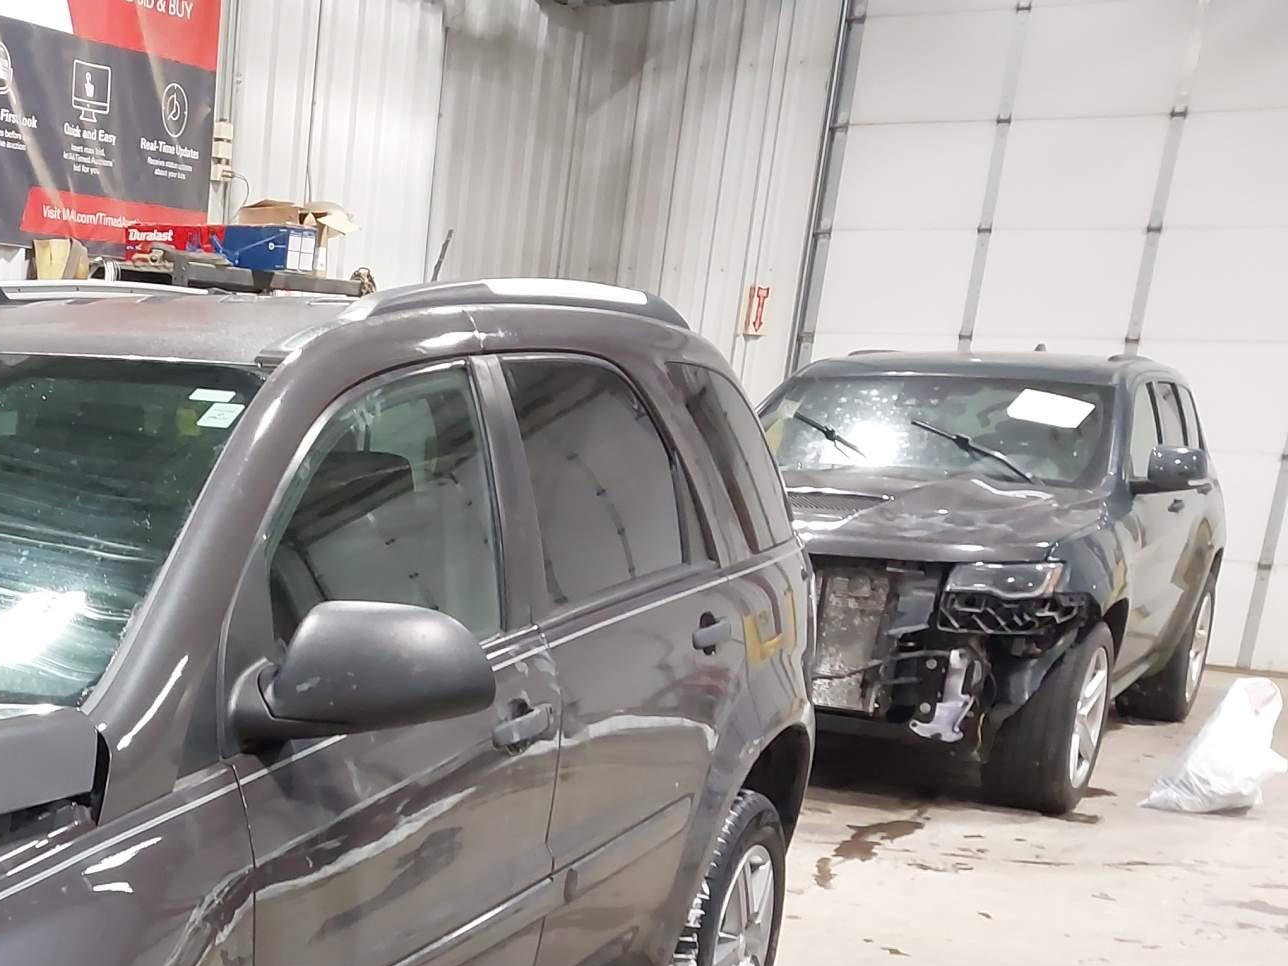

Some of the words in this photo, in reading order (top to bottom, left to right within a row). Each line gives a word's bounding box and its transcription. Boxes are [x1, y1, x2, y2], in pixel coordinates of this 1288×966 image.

[168, 0, 193, 20] BUY
[63, 122, 82, 138] Quick
[82, 128, 97, 141] and
[98, 129, 117, 146] Easy
[140, 136, 176, 155] Real-Time
[175, 143, 200, 160] Updates
[42, 205, 62, 220] Visit
[128, 228, 174, 241] Duralast
